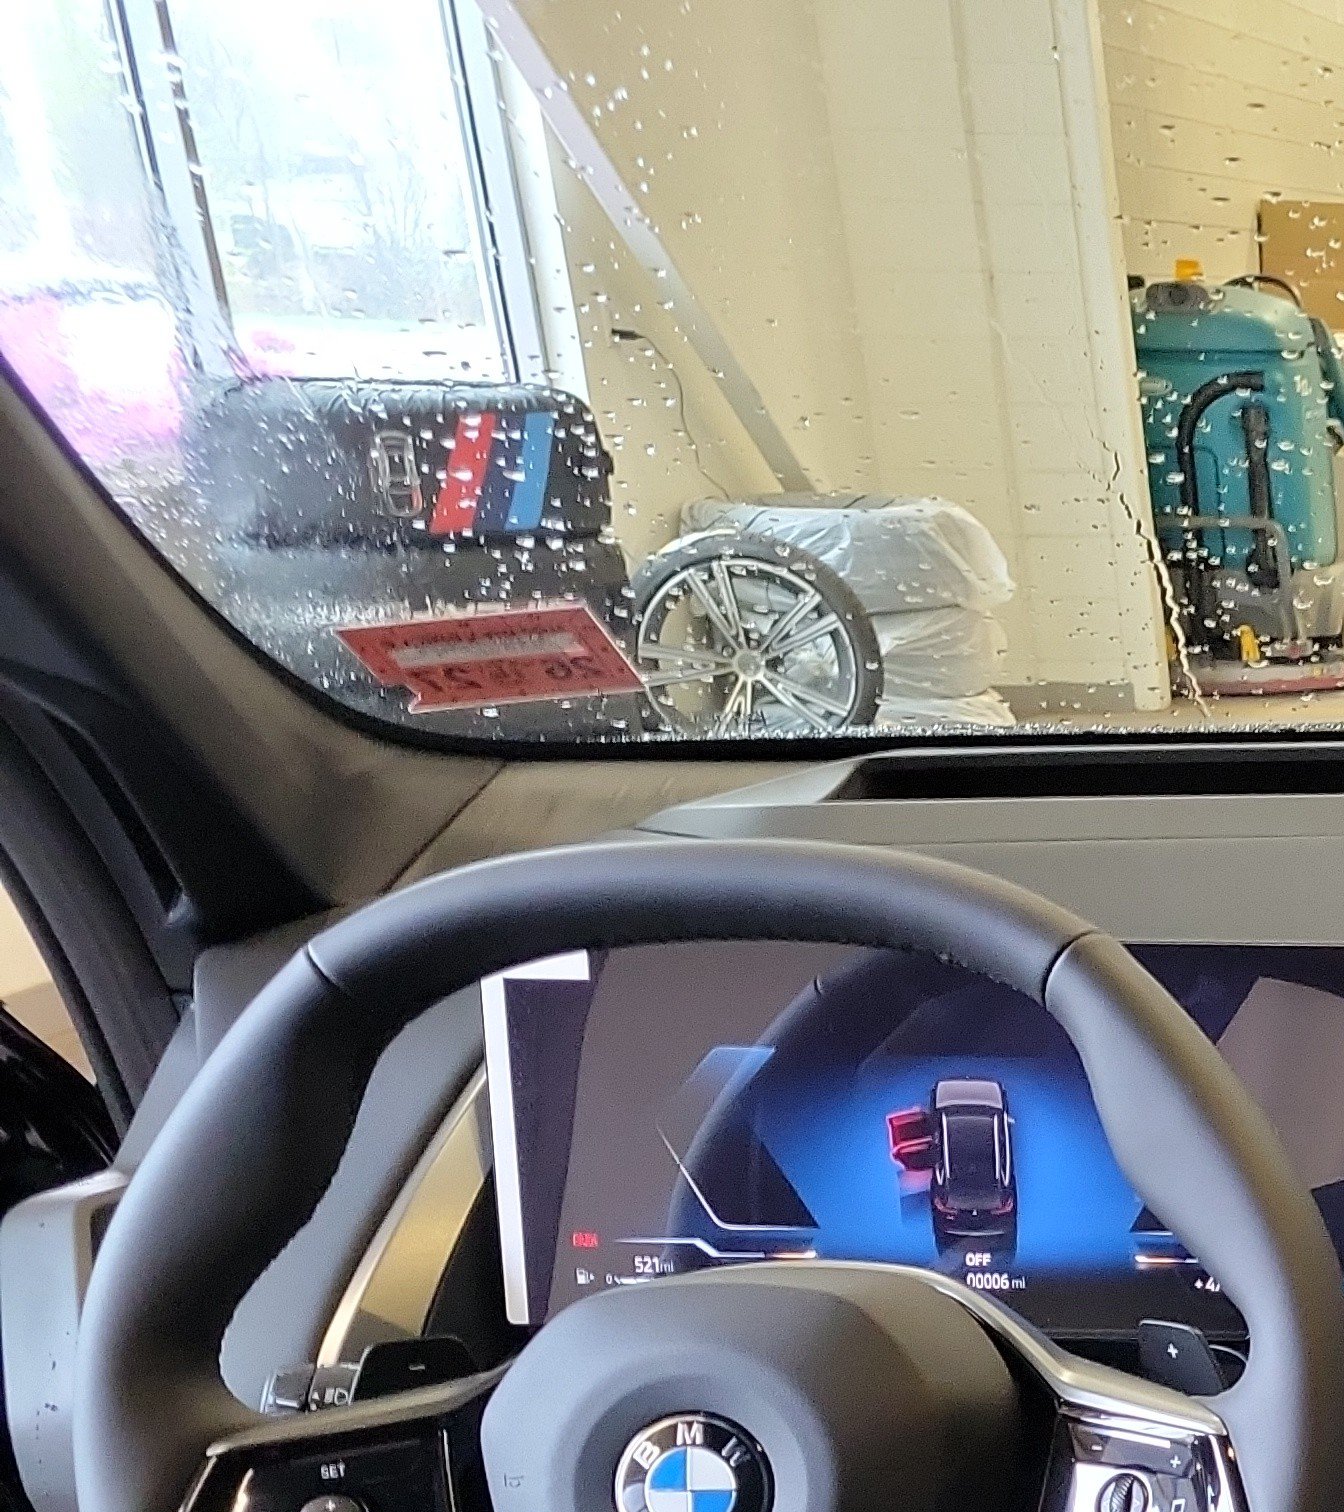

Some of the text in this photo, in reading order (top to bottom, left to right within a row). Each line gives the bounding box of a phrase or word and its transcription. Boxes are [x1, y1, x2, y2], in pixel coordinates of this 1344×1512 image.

[965, 1252, 991, 1266] OFF
[633, 1420, 752, 1470] BMW
[320, 1460, 346, 1479] SET
